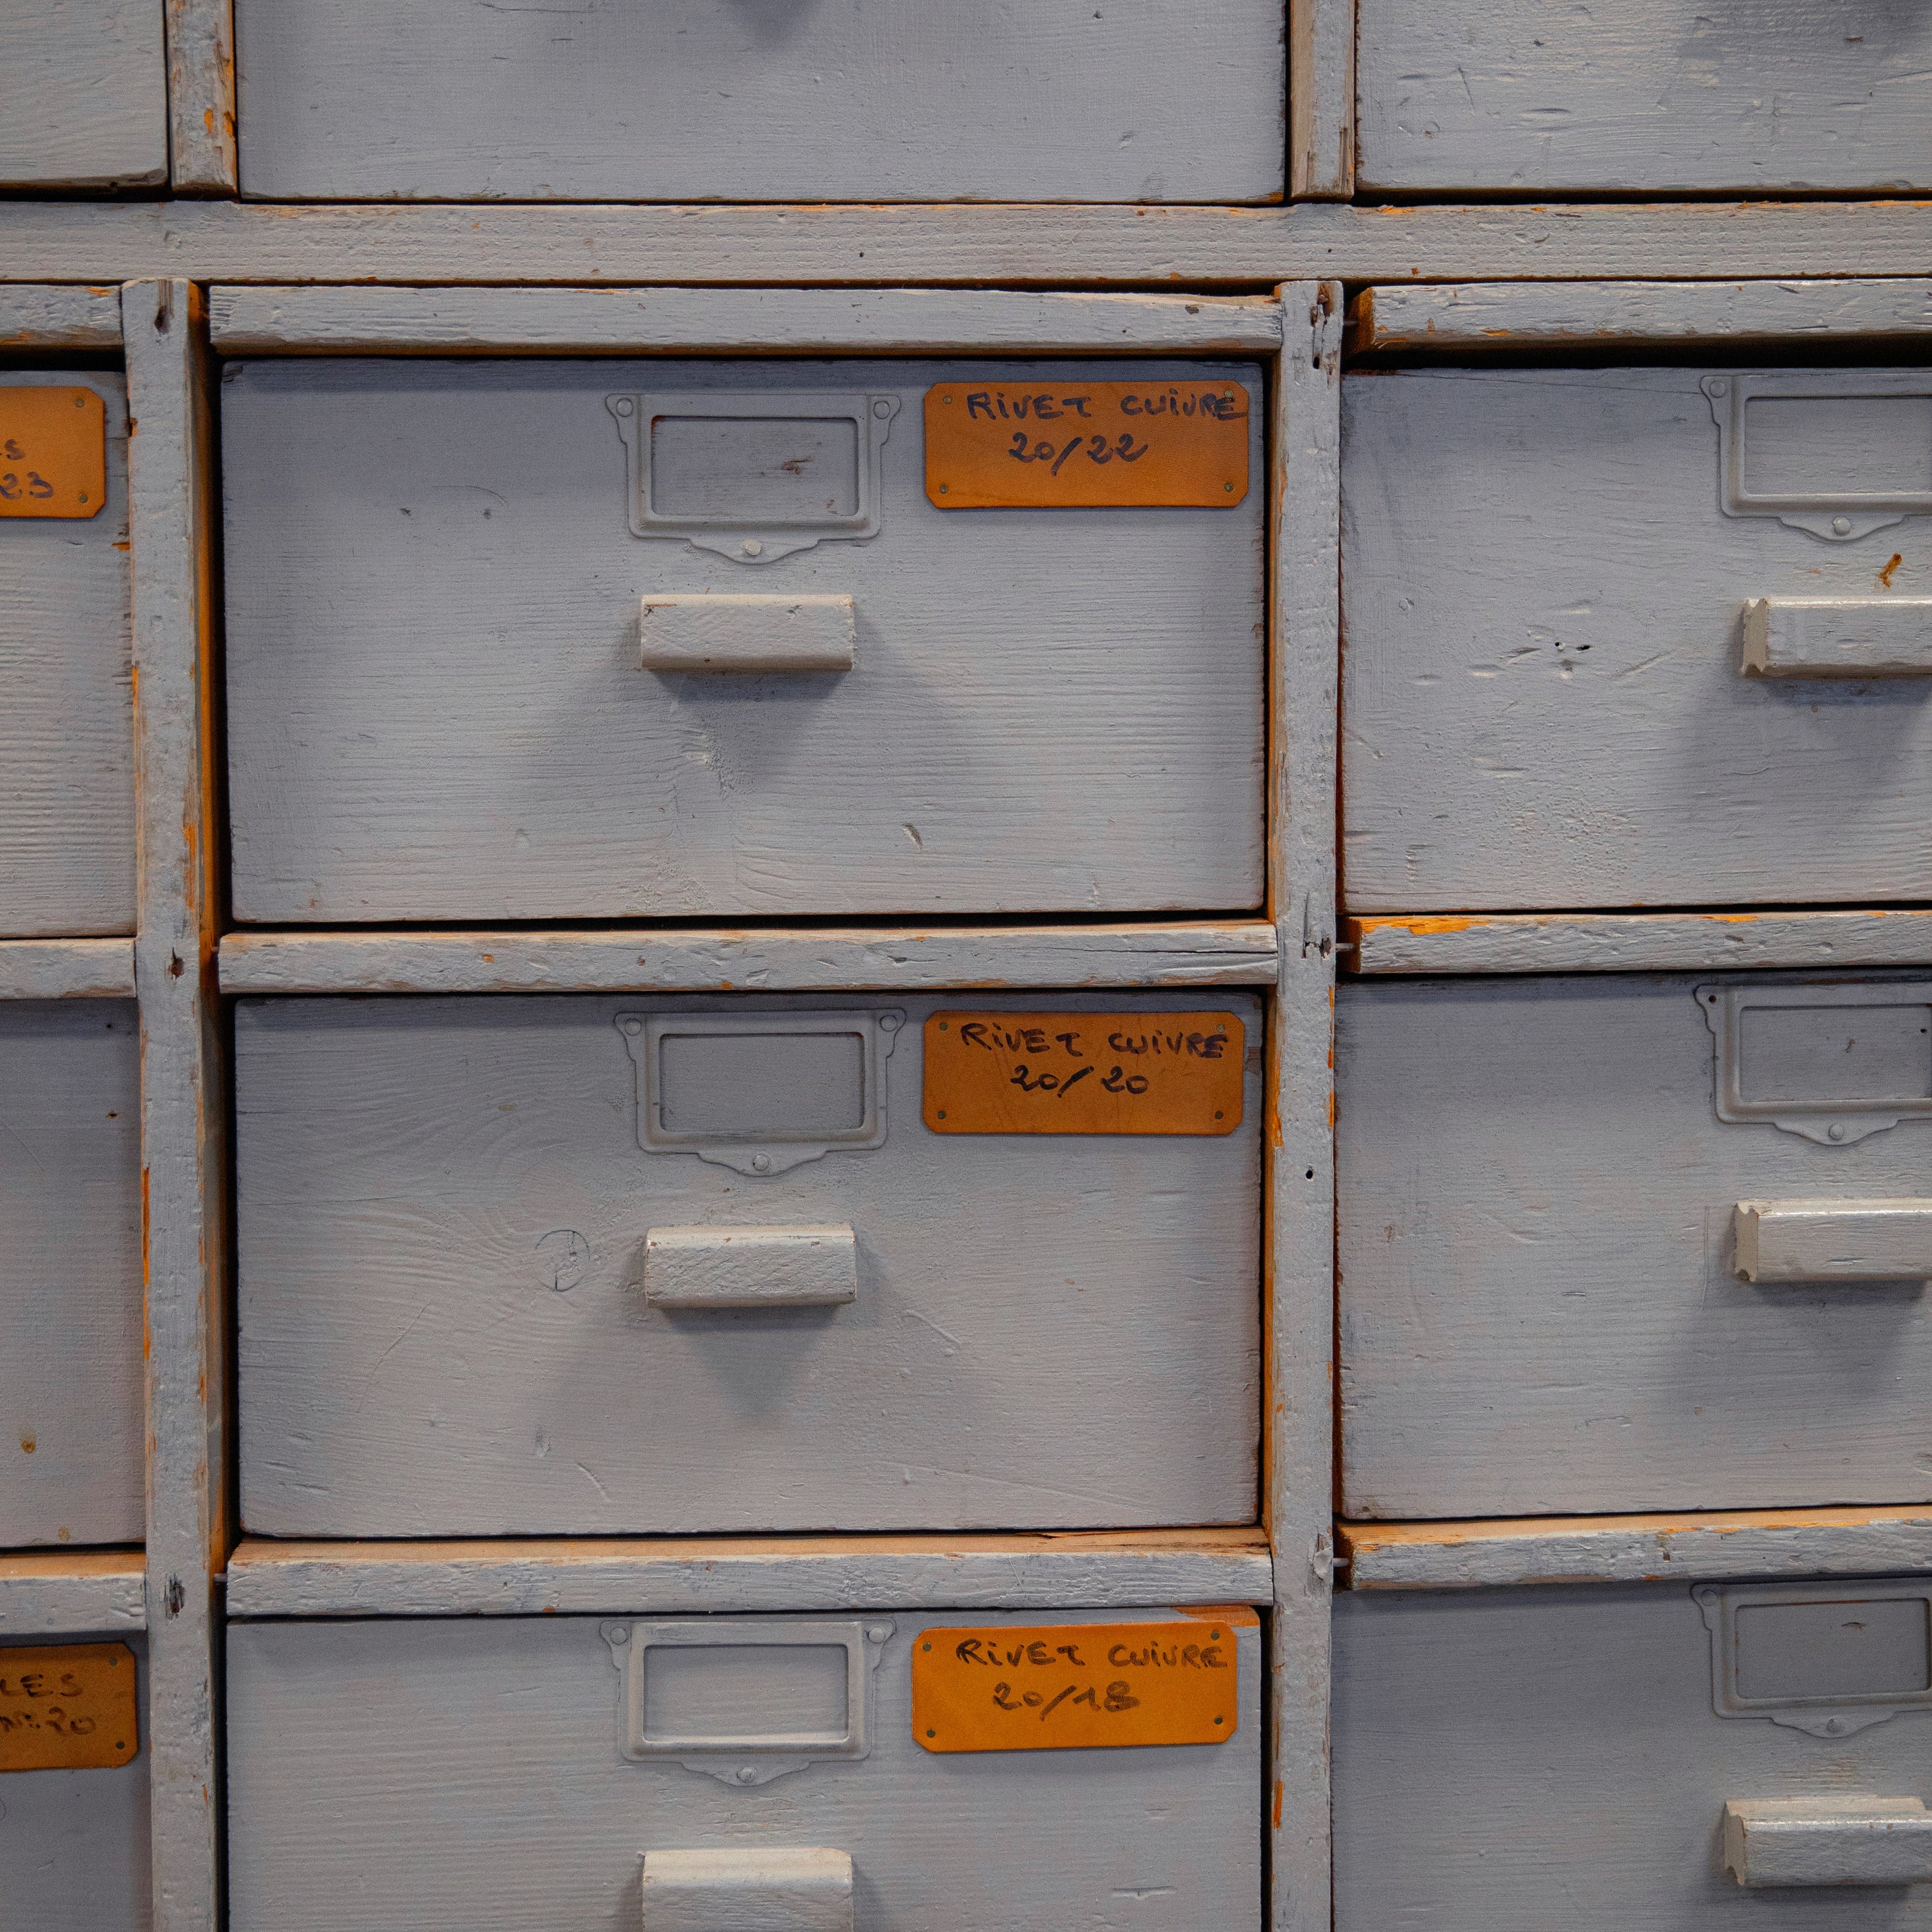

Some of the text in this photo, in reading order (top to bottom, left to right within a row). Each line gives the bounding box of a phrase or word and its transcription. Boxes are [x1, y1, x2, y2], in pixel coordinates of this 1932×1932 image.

[1008, 431, 1149, 476] 20/22
[1010, 1064, 1150, 1098] 20/20
[992, 1680, 1141, 1721] 20/18
